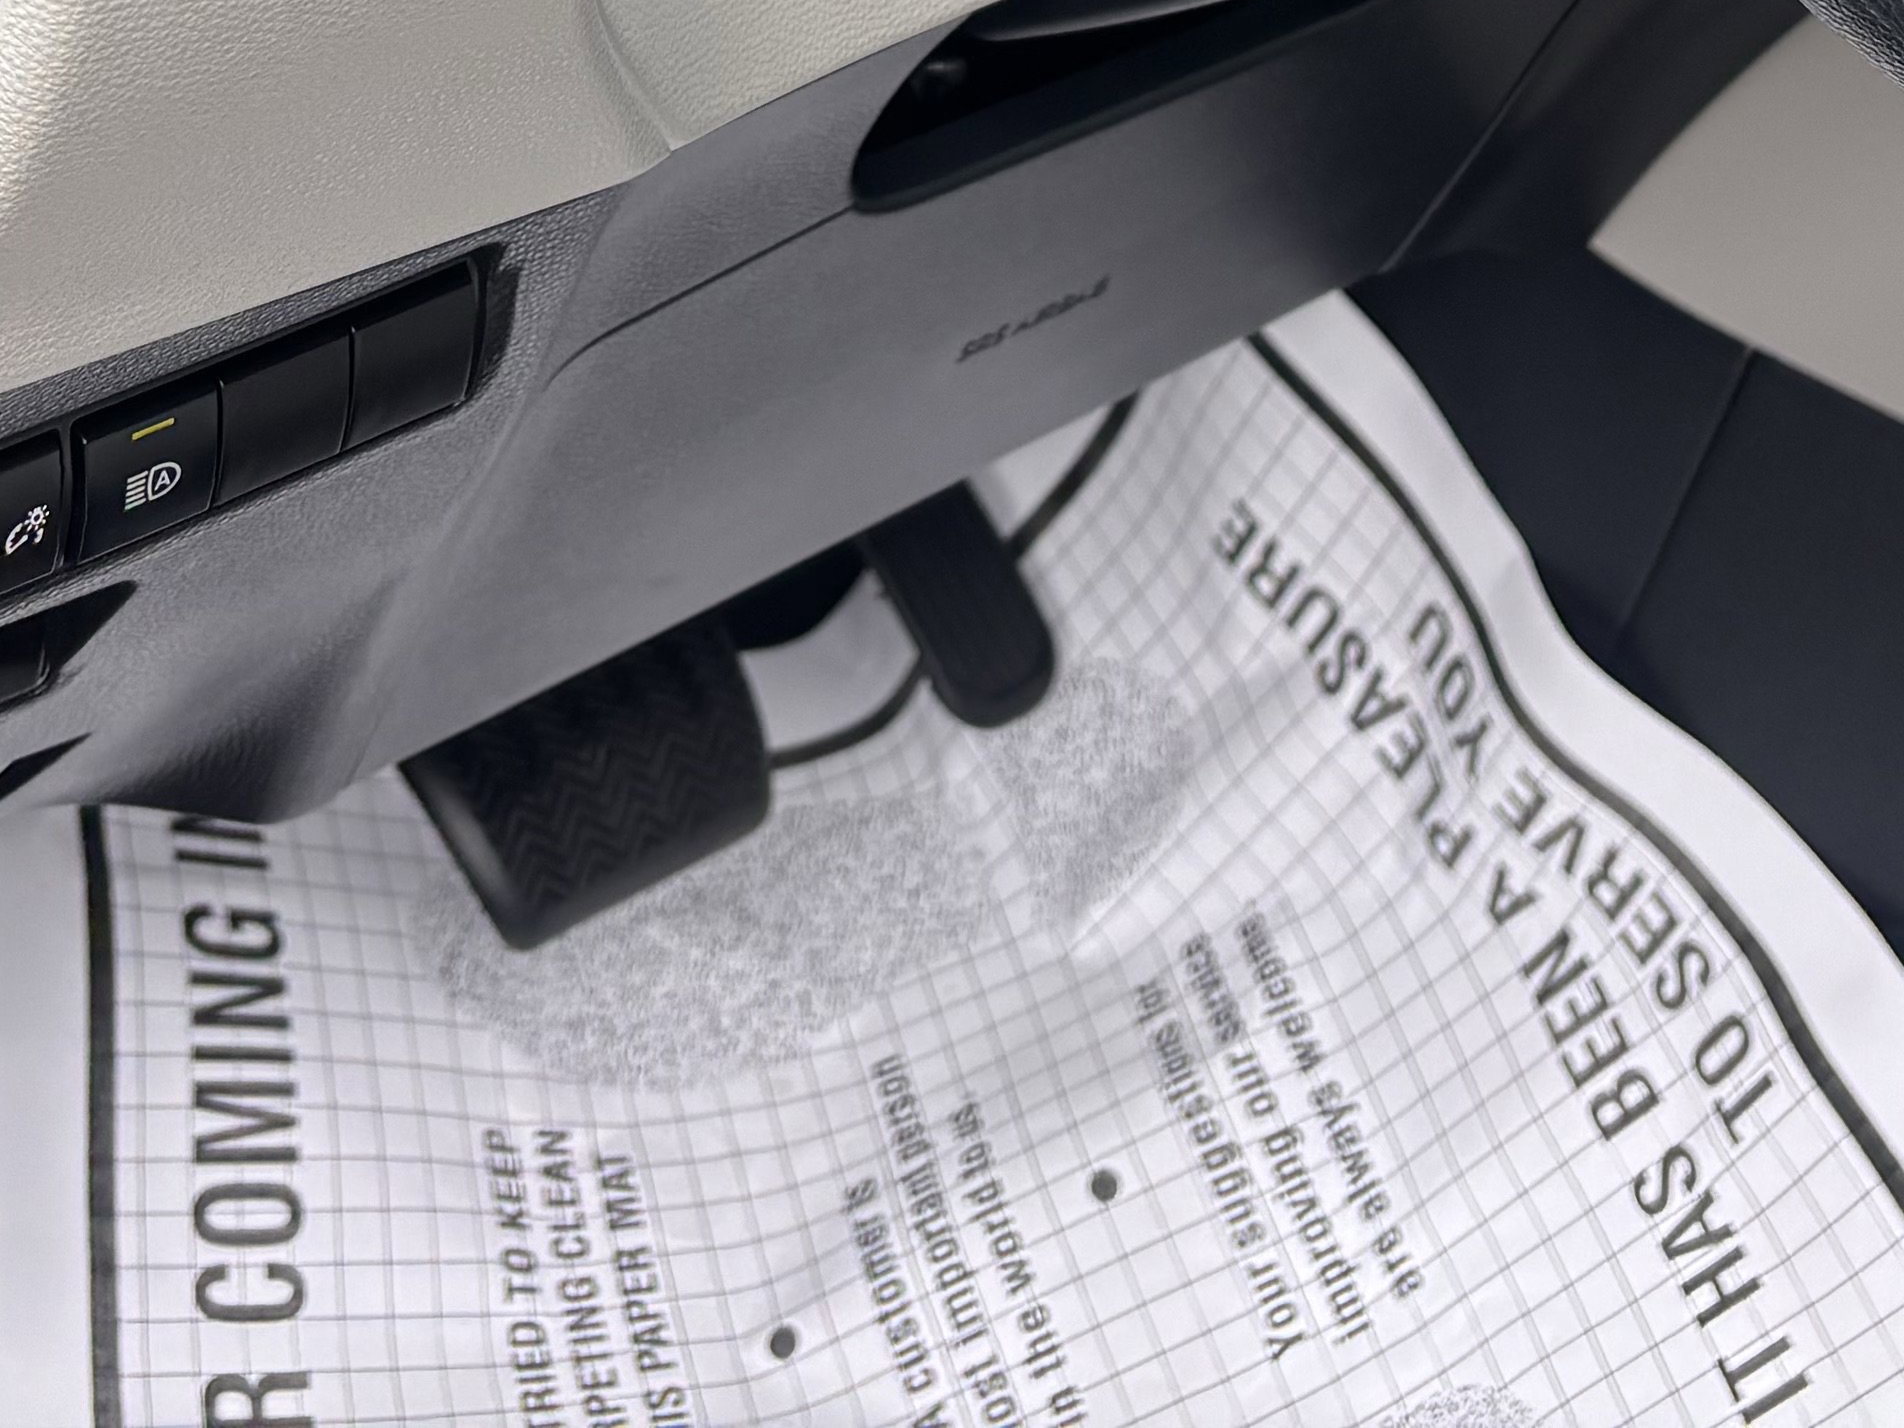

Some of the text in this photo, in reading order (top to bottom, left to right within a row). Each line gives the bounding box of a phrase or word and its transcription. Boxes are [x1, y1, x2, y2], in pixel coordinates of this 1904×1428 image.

[1409, 604, 1774, 1145] TO SERVE YOU
[1212, 497, 1811, 1427] IT HAS BEEN A PLEASURE
[183, 903, 305, 1323] COMING
[1152, 1020, 1267, 1250] suggestions
[1225, 1050, 1278, 1118] our
[484, 1129, 530, 1231] KEEP
[594, 1153, 646, 1231] MAT
[957, 1142, 994, 1181] to
[1308, 1080, 1392, 1222] always
[500, 1247, 542, 1304] TO
[535, 1130, 627, 1428] PETING CLEAN
[899, 1160, 987, 1348] important
[964, 1178, 1035, 1296] world
[1262, 1126, 1372, 1346] improving
[1374, 1225, 1426, 1299] are
[615, 1245, 678, 1372] PAPER
[853, 1213, 934, 1394] customer
[1019, 1302, 1067, 1379] the
[1247, 1260, 1307, 1361] Your
[963, 1353, 1022, 1428] ost
